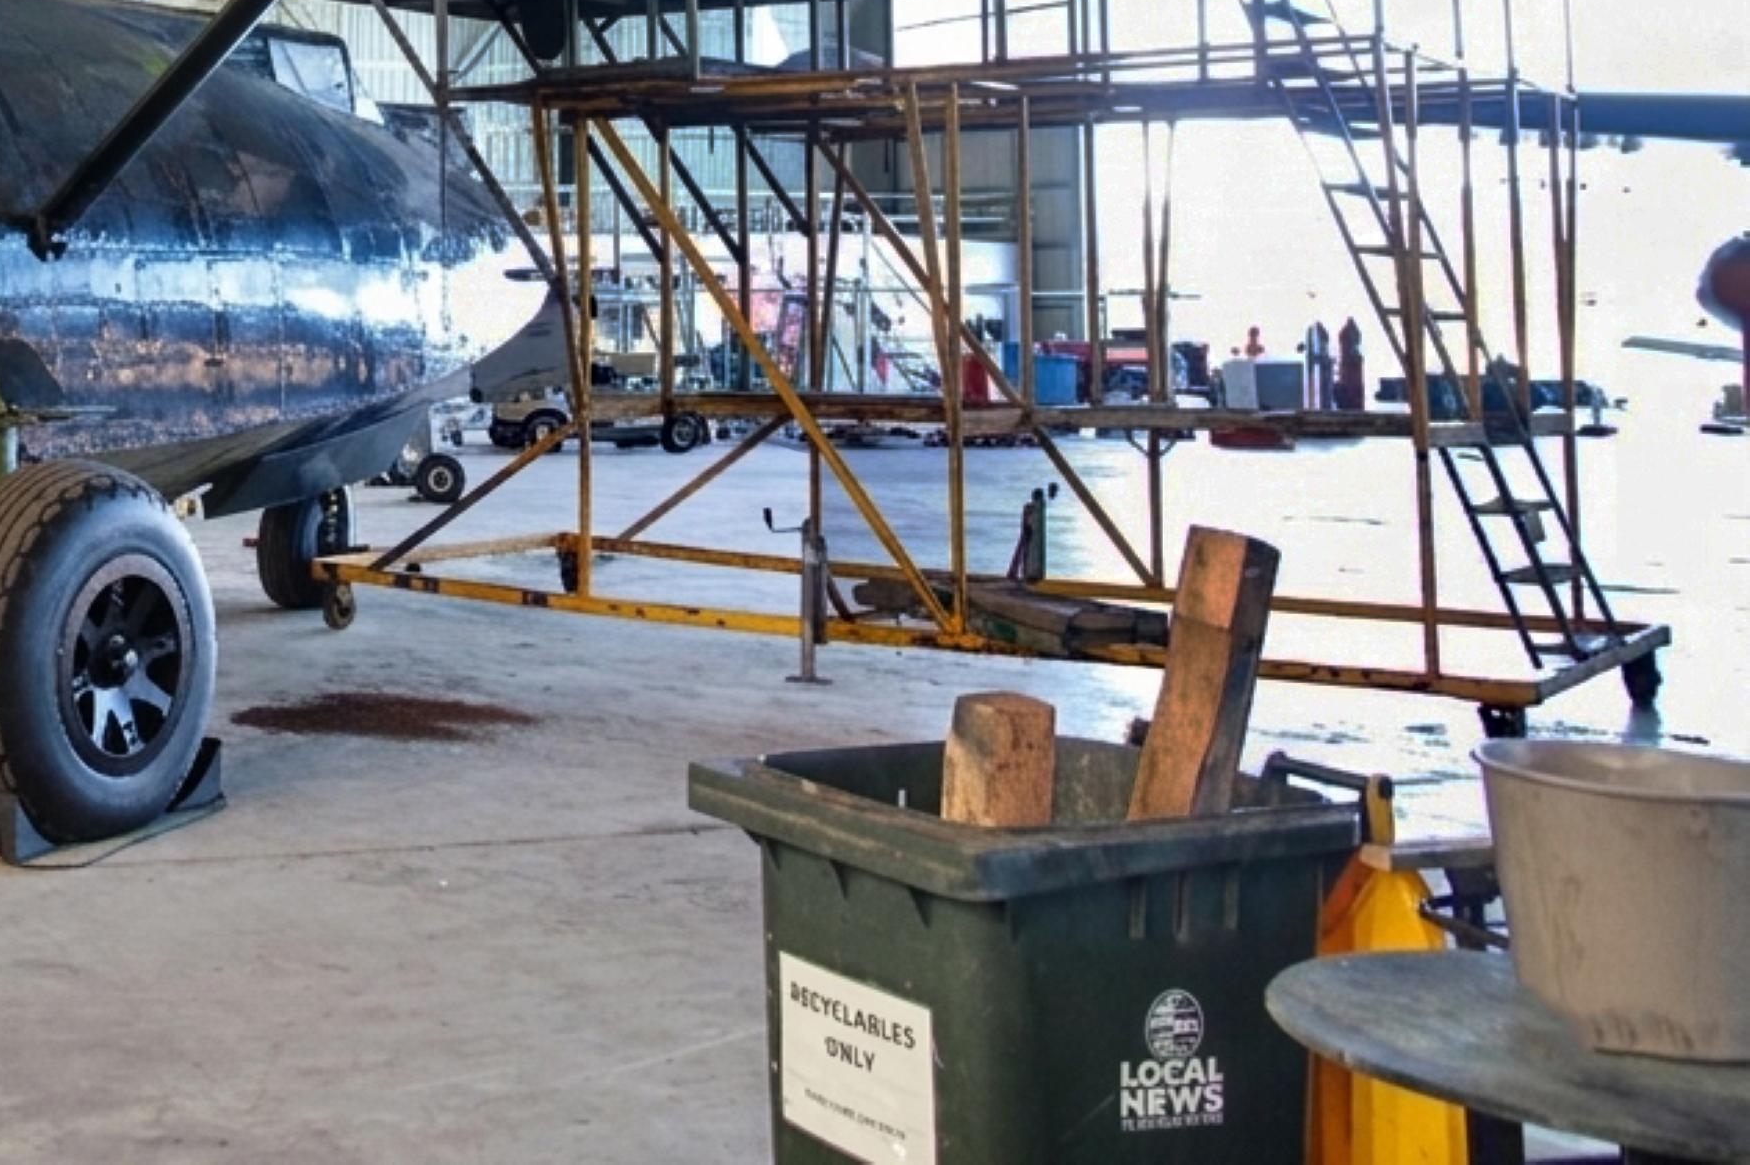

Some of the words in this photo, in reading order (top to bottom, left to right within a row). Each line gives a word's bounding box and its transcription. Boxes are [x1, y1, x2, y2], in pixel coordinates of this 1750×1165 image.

[824, 1036, 875, 1073] ONLY
[1120, 1056, 1224, 1087] LOCAL
[1120, 1084, 1224, 1118] NEWS
